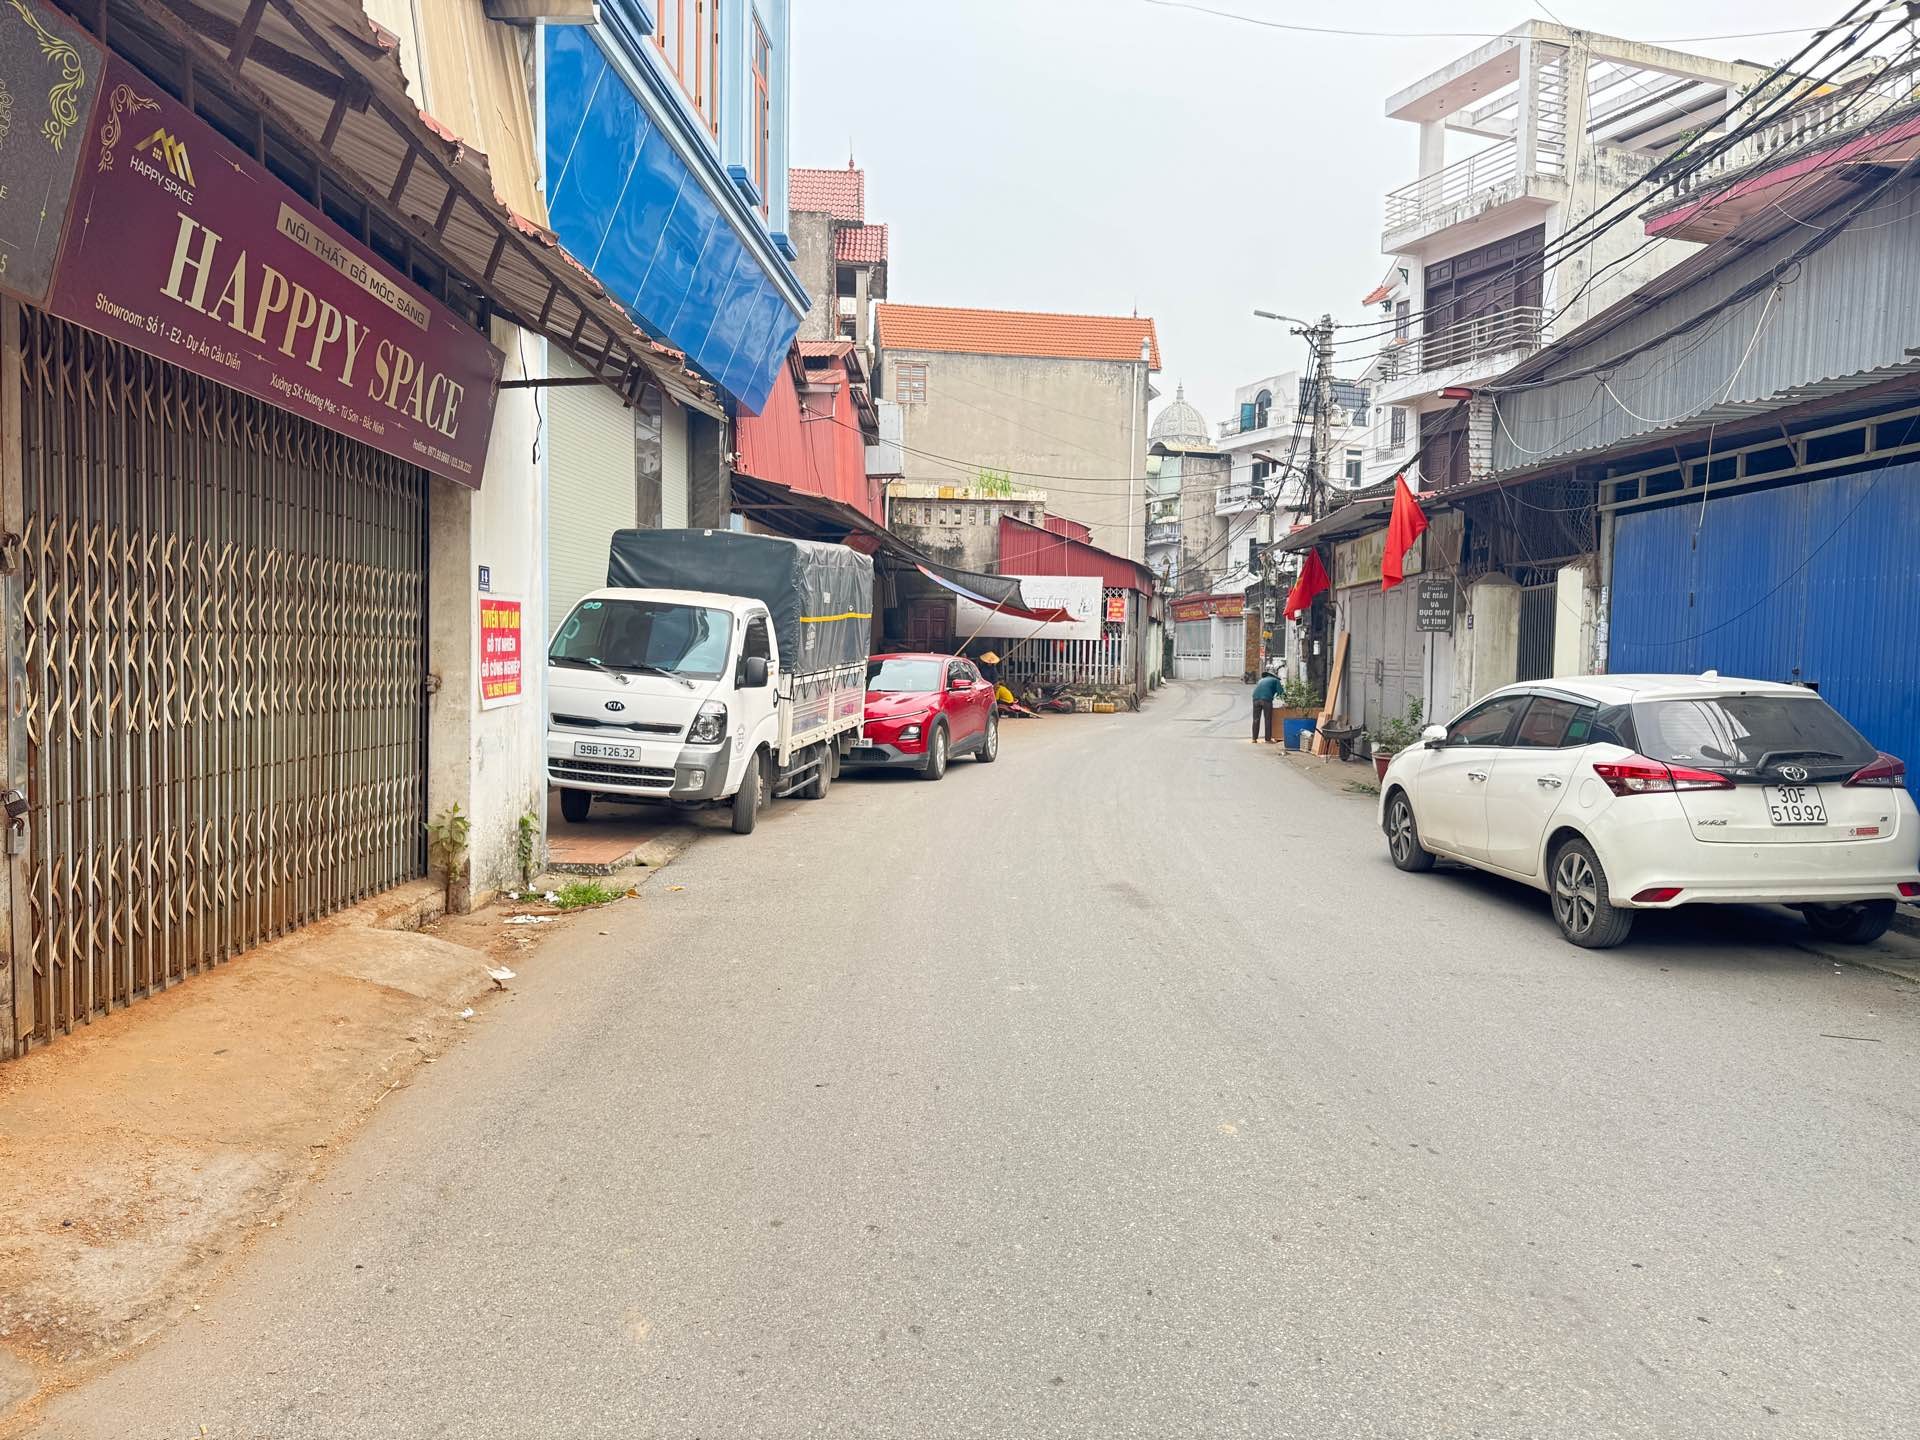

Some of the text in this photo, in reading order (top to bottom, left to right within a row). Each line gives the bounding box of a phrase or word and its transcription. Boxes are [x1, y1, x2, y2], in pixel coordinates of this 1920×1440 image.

[130, 155, 194, 205] HAPPY SPACE
[285, 217, 425, 325] NỘI THẤT GỖ MỘC SÁNG
[95, 292, 145, 329] Showroom:
[146, 313, 159, 334] Số
[159, 322, 165, 337] 1
[170, 326, 182, 344] E2
[186, 334, 199, 355] Dự
[159, 211, 465, 440] HAPPPY SPACE
[607, 702, 623, 710] KIA
[580, 744, 635, 758] 99B-126.32
[1779, 787, 1805, 804] 30F
[1771, 805, 1825, 822] 519.92
